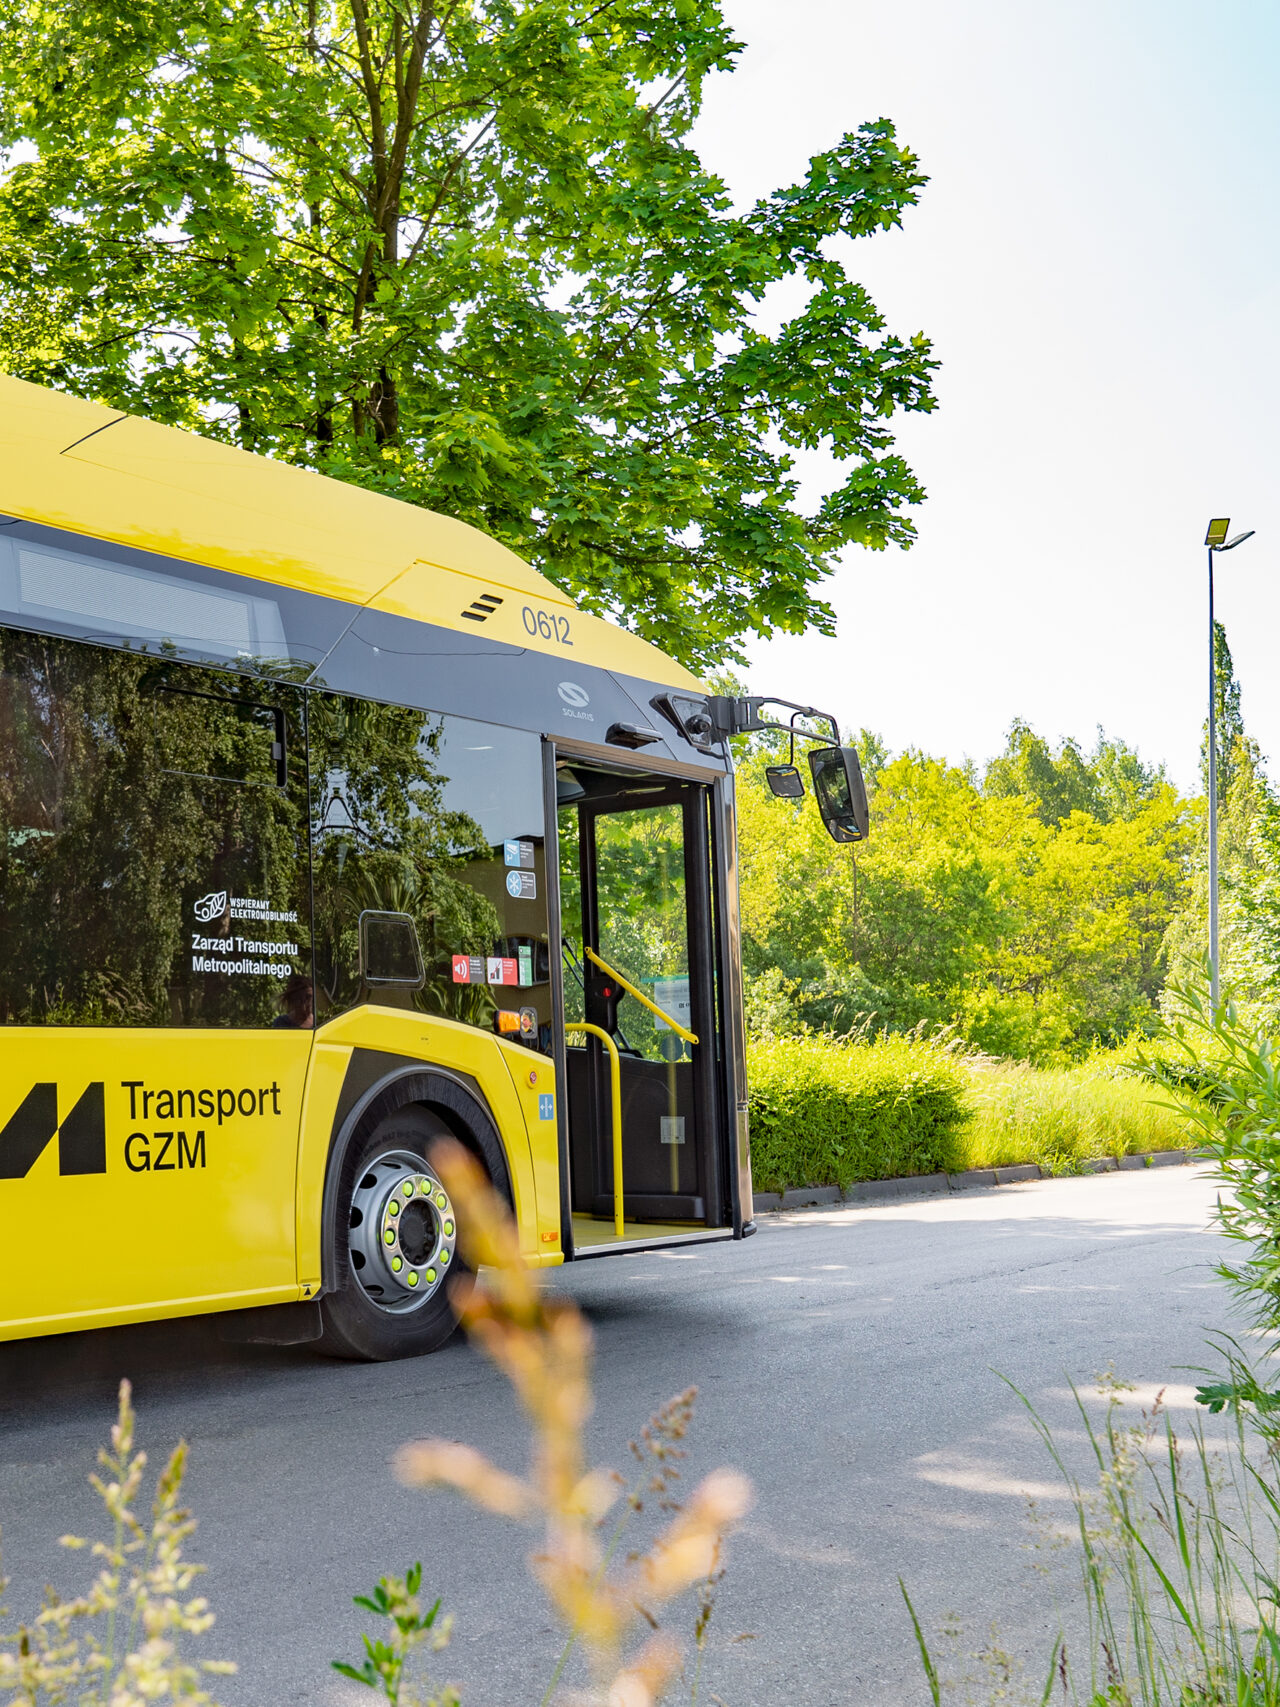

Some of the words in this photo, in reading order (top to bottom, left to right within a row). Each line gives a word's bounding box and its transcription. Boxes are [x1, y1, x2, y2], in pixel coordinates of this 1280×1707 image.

[522, 606, 573, 645] 0612
[562, 708, 594, 721] SOLARIS
[229, 898, 269, 909] WSPIERAMY
[230, 909, 298, 922] ELEKTROMOBILNOŚĆ
[192, 934, 233, 954] Zarząd
[235, 937, 298, 956] Transportu
[192, 956, 292, 979] Metropolitalnego
[121, 1081, 280, 1125] Transport
[125, 1130, 206, 1172] GZM
